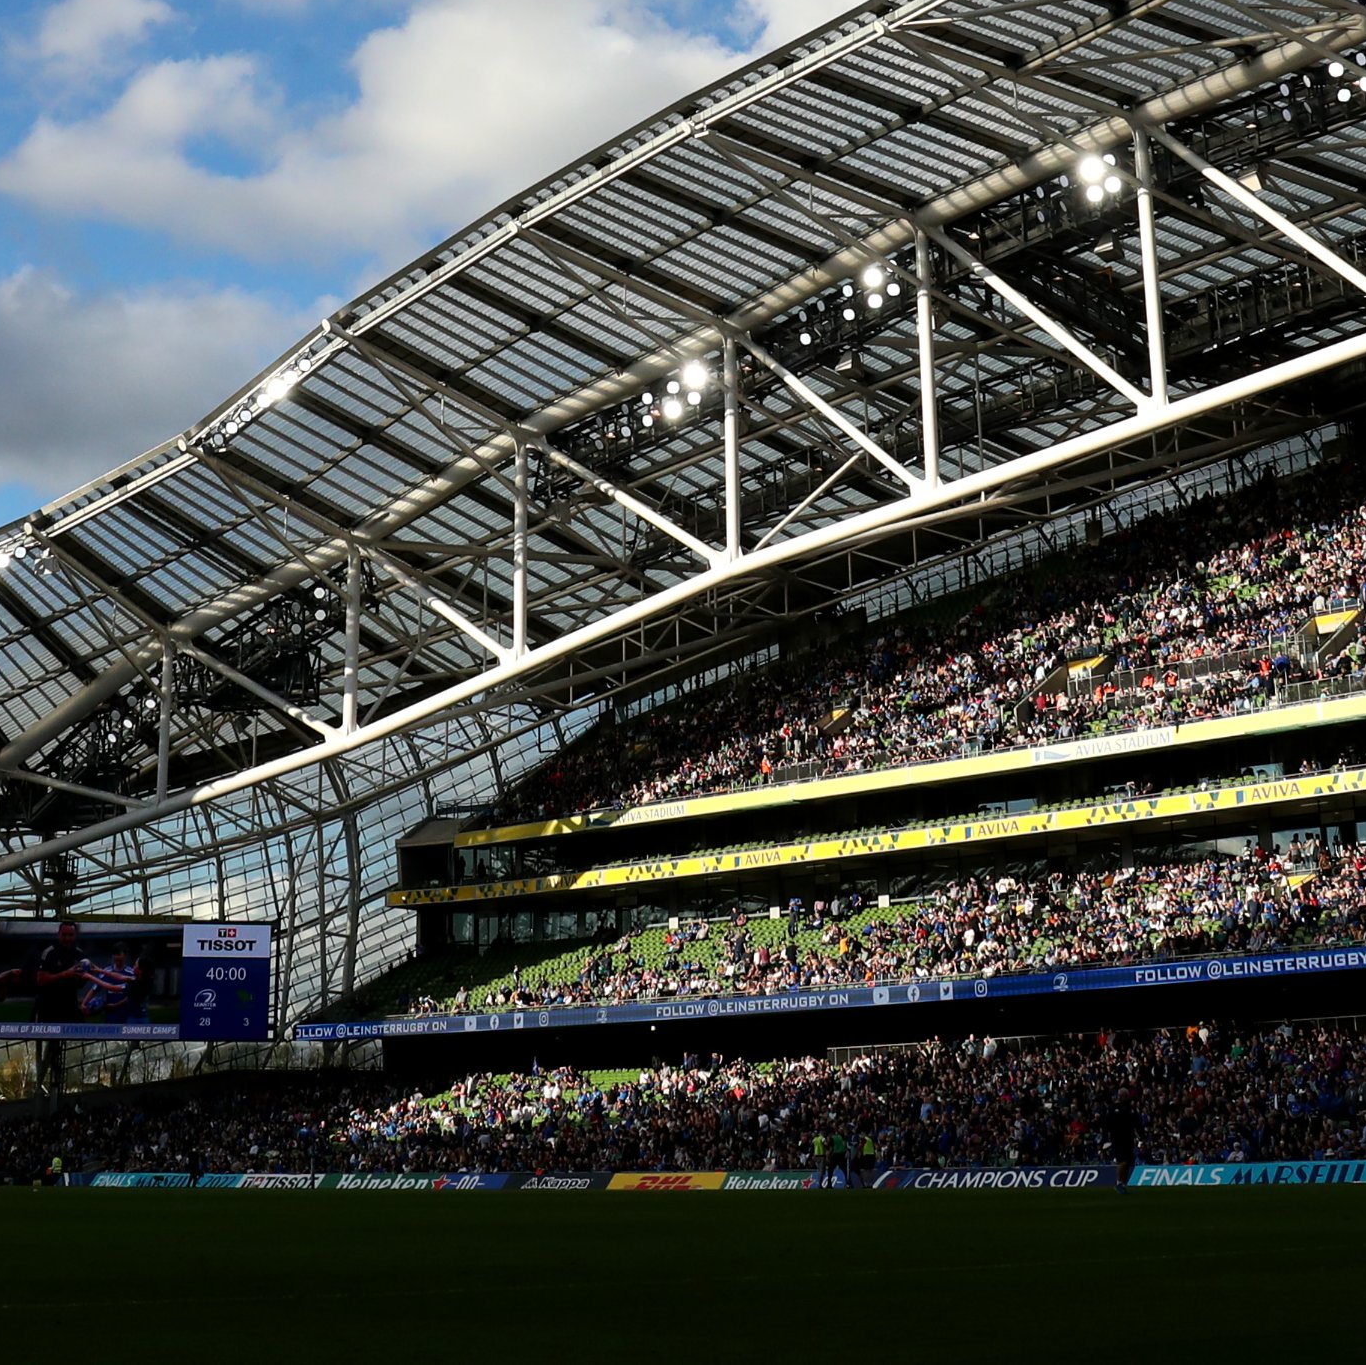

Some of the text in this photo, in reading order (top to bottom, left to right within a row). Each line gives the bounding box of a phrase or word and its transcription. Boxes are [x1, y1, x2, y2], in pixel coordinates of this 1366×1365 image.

[1075, 731, 1171, 757] AVIVA STADIUM
[1252, 782, 1300, 801] AVIVA
[644, 805, 685, 820] STADIUM
[977, 820, 1020, 837] AVIVA
[745, 851, 781, 866] AVIVA
[197, 940, 257, 951] TISSOT
[206, 967, 247, 981] 40:00
[1135, 965, 1202, 984] FOLLOW
[655, 992, 849, 1018] FOLLOW @LEINSTERRUGBY ON
[199, 1017, 211, 1027] 28
[243, 1017, 250, 1027] 3
[0, 1025, 20, 1034] BANK
[20, 1025, 30, 1034] OF
[31, 1025, 61, 1034] IRELAND
[122, 1026, 152, 1035] SUMMER
[152, 1026, 177, 1035] CAMPS
[336, 1022, 430, 1039] @LEINSTERRUGBY
[432, 1021, 447, 1031] ON
[95, 1174, 135, 1187] FINALS
[204, 1174, 235, 1188] 2022
[261, 1175, 320, 1189] TISSOT
[335, 1174, 429, 1190] Heineken
[539, 1176, 591, 1190] Kappa
[637, 1175, 695, 1190] DHL
[724, 1175, 800, 1191] Heineken
[914, 1169, 1100, 1189] CHAMPIONS CUP
[1137, 1167, 1223, 1186] FINALS
